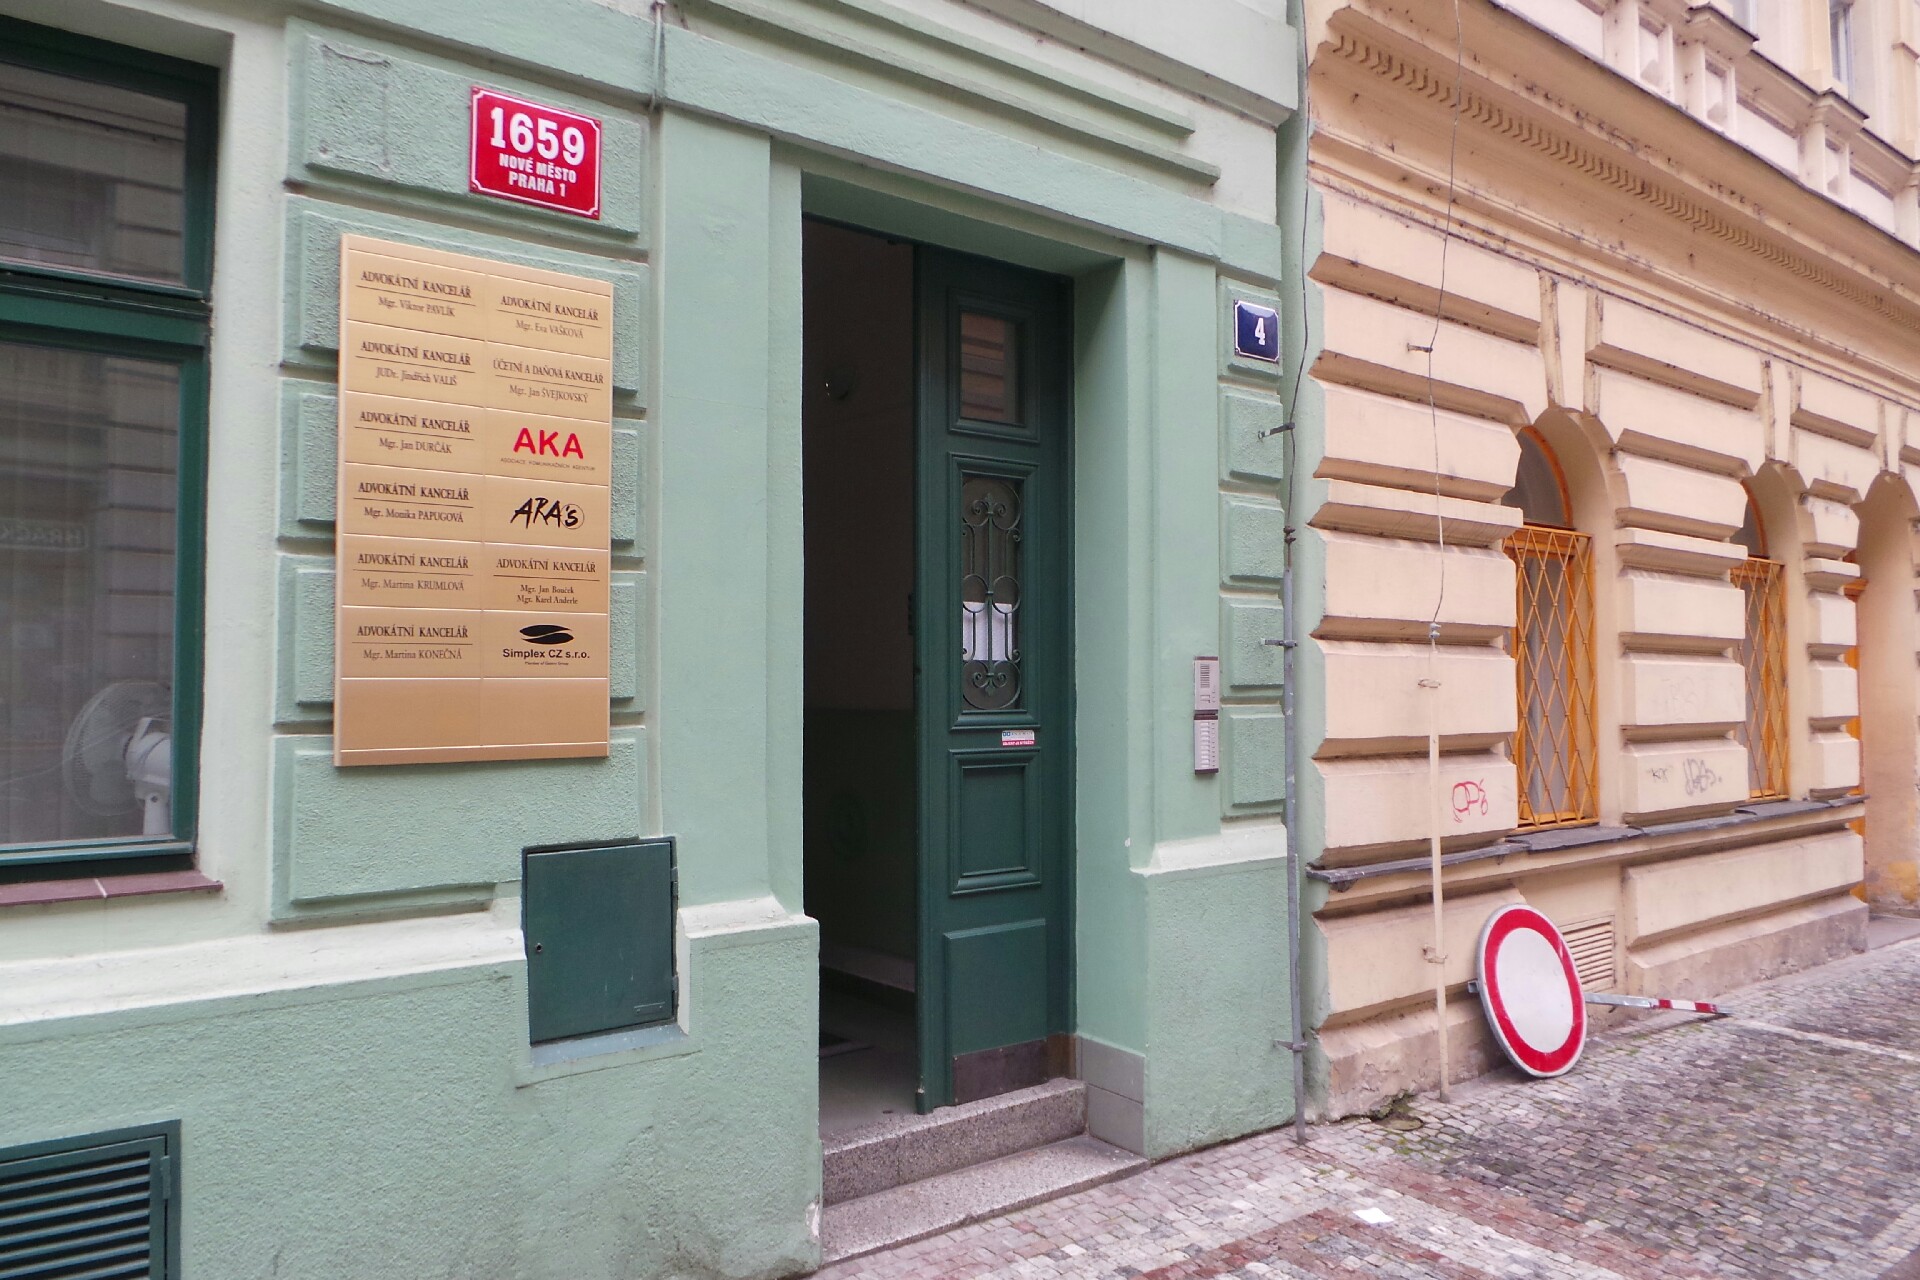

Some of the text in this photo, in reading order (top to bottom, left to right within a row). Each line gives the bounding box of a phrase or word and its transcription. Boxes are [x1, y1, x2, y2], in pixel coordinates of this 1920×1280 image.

[490, 107, 584, 165] 1659
[499, 153, 577, 183] NOVÉ MĚSTO
[508, 171, 566, 197] PRAHA 1
[361, 271, 471, 298] ADVOKÁTNÍ KANCELÁŘ
[378, 296, 455, 317] Mgr. Viktor PAVLÍK
[501, 295, 599, 321] ADVOKÁTNÍ KANCELÁŘ
[516, 319, 584, 338] Mgr. Eva VAŠKOVÁ
[1254, 317, 1266, 346] 4
[361, 341, 471, 366] ADVOKÁTNÍ KANCELÁŘ
[375, 367, 457, 386] JUDr. Jindřich VALIŠ
[493, 358, 604, 384] ÚČETNÍ A DAŇOVÁ KANCELÁŘ
[509, 384, 588, 404] Mgr. Jan ŠVEJKOVSKÝ
[360, 411, 470, 433] ADVOKÁTNÍ KANCELÁŘ
[379, 438, 452, 453] Mgr. Jan DURČÁK
[513, 427, 584, 459] AKA
[358, 482, 470, 501] ADVOKÁTNÍ KANCELÁŘ
[364, 507, 464, 523] Mgr. Monika PAPUGOVÁ
[357, 553, 469, 569] ADVOKÁTNÍ KANCELÁŘ
[496, 558, 596, 573] ADVOKÁTNÍ KANCELÁŘ
[361, 578, 464, 591] Mgr. Martina KRUMLOVÁ
[520, 584, 574, 594] Mgr. Jan Bouček
[517, 595, 578, 605] Mgr. Karel Anderle
[357, 624, 468, 638] ADVOKÁTNÍ KANCELÁŘ
[363, 648, 462, 660] Mgr. Martina KONEČNÁ
[503, 648, 590, 660] Simplex CZ s.r.o.
